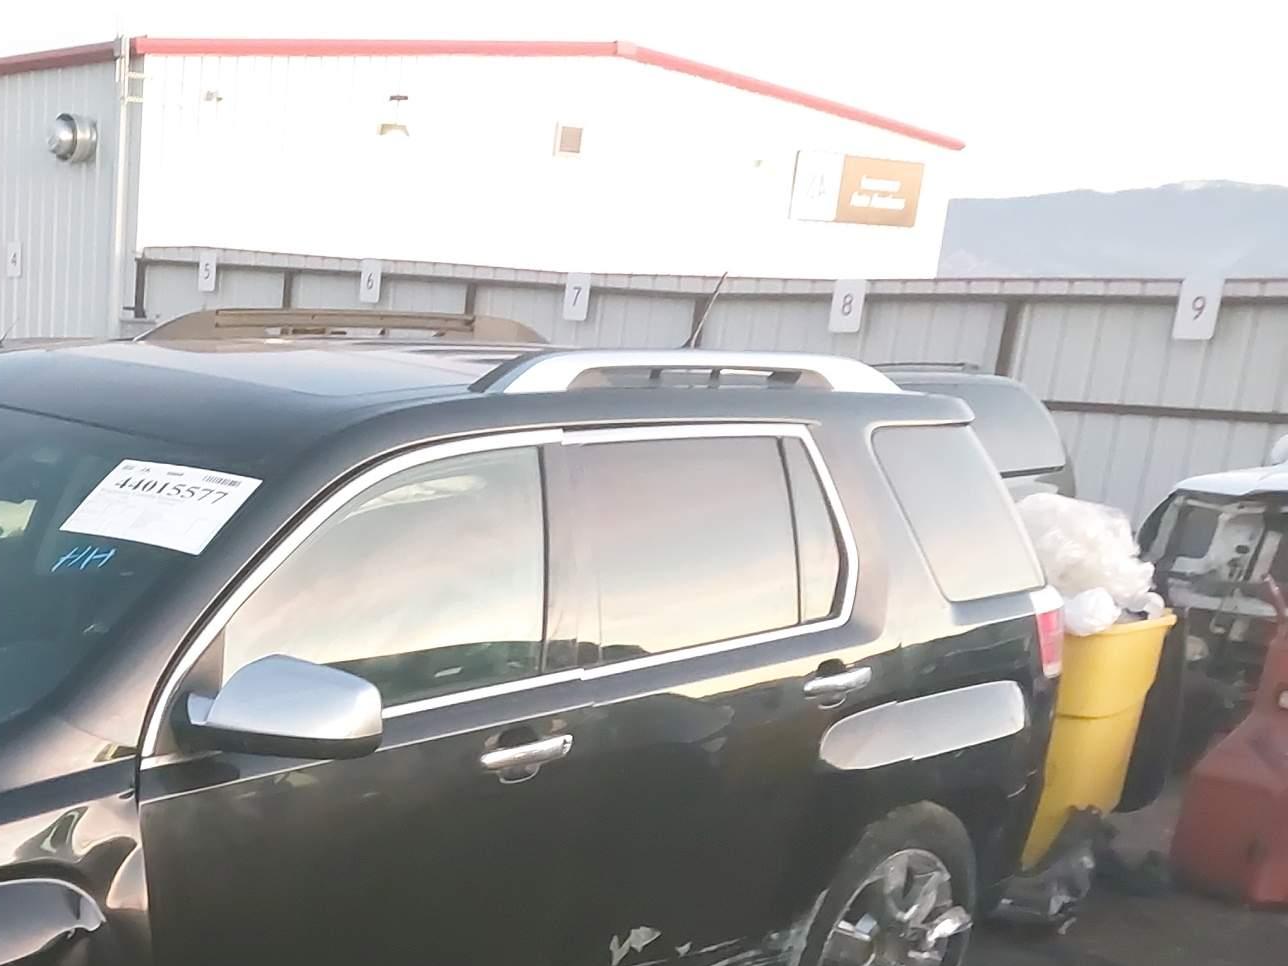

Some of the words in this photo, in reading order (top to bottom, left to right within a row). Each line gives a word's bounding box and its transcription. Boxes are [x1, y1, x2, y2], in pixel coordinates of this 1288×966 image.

[9, 252, 18, 266] 4
[202, 262, 211, 281] 5
[365, 272, 375, 290] 6
[571, 286, 583, 307] 7
[840, 293, 854, 317] 8
[1190, 295, 1207, 321] 9
[114, 476, 230, 505] 44015577
